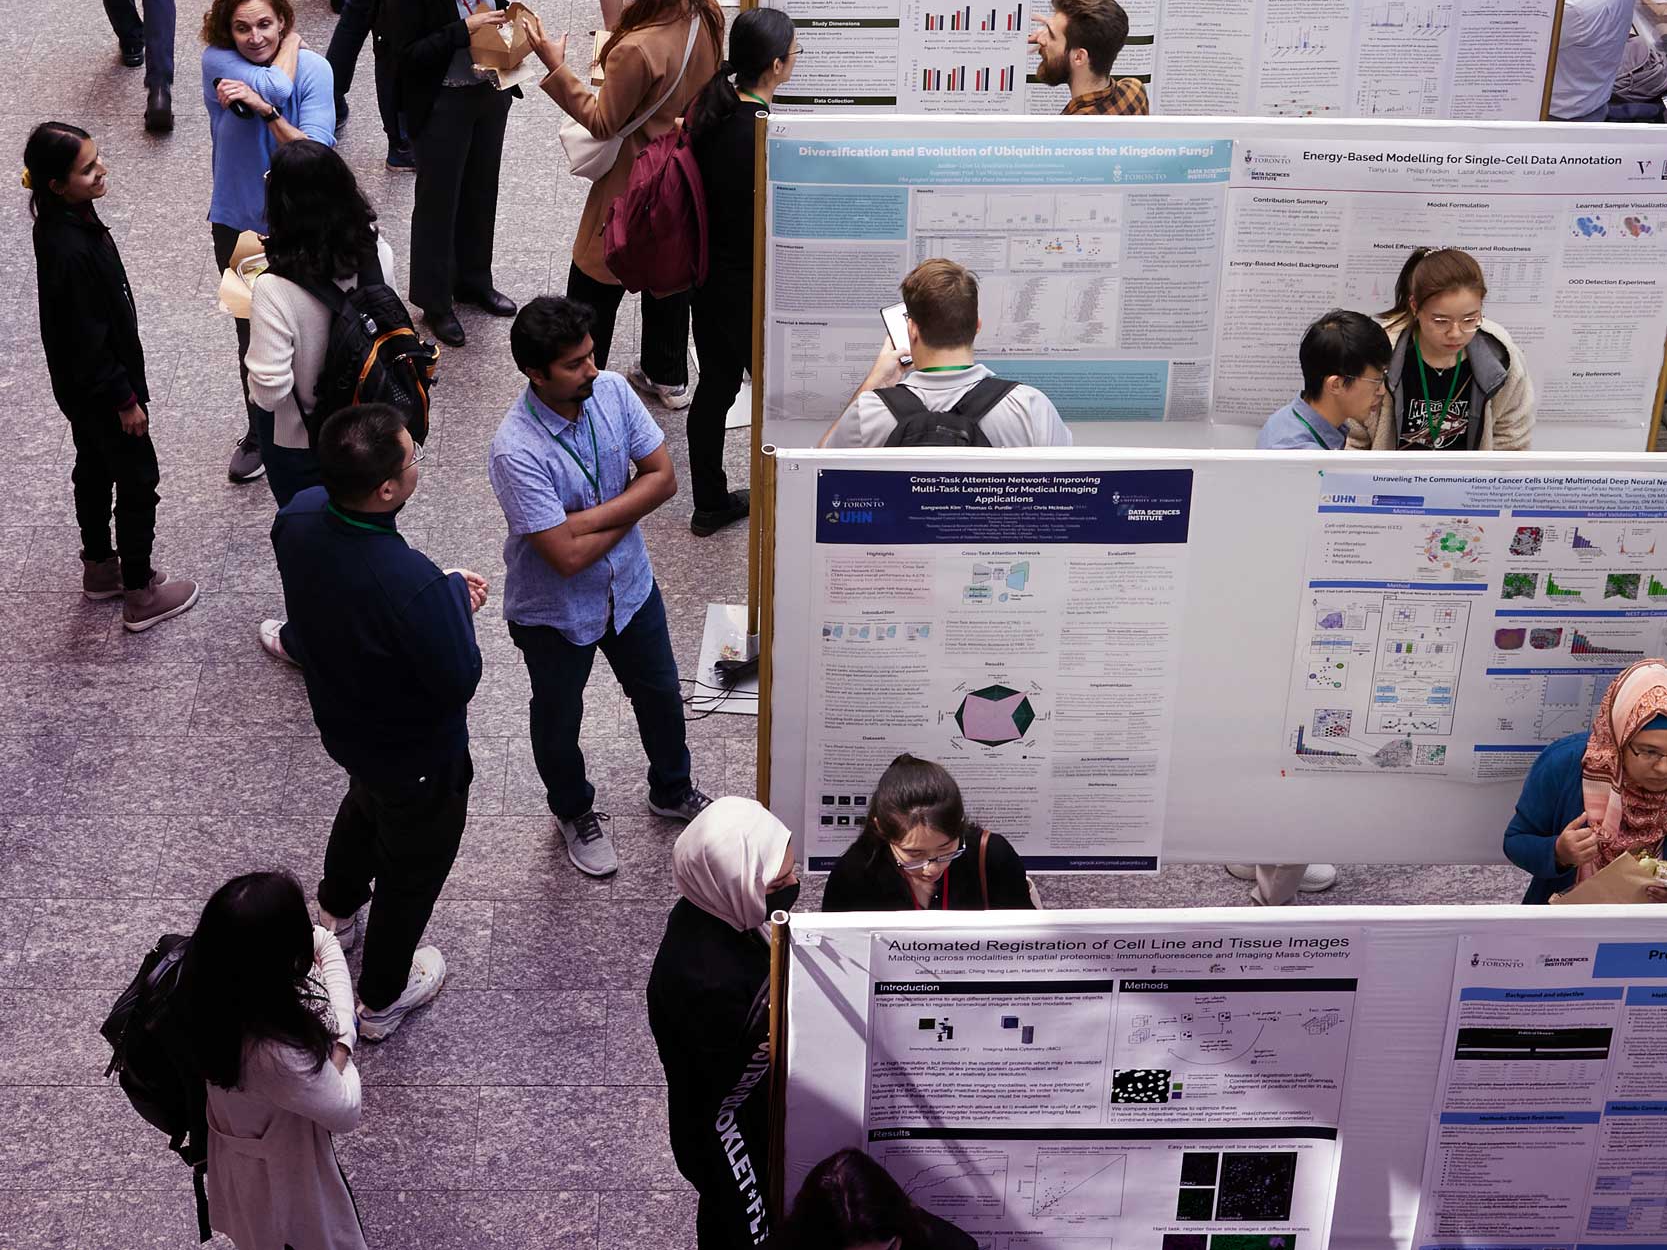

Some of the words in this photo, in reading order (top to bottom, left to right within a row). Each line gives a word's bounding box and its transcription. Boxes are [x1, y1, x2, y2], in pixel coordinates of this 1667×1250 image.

[798, 146, 889, 157] Diversification
[891, 146, 915, 157] and
[917, 146, 977, 157] Evolution
[979, 145, 993, 156] of
[994, 145, 1053, 156] Ubiquitin
[1054, 147, 1095, 156] across
[1096, 146, 1118, 156] the
[1119, 145, 1177, 158] Kingdom
[1178, 145, 1214, 157] Fungi
[1303, 151, 1384, 164] Energy-Based
[1386, 153, 1444, 166] Modelling
[1446, 154, 1462, 164] for
[1465, 154, 1528, 167] Single-Cell
[1531, 155, 1557, 165] Data
[1559, 155, 1622, 165] Annotation
[962, 476, 1006, 484] Attention
[1053, 477, 1101, 485] Improving
[1372, 476, 1413, 484] Unraveling
[1429, 476, 1487, 484] Communication
[1543, 477, 1564, 486] Using
[1565, 477, 1608, 485] Multimodal
[1609, 478, 1630, 486] Deep
[911, 485, 960, 493] Multi-Task
[962, 486, 1004, 495] Learning
[1005, 485, 1019, 493] for
[1020, 485, 1058, 493] Medical
[1059, 485, 1098, 495] Imaging
[974, 495, 1034, 504] Applications
[1332, 495, 1356, 504] UHN
[887, 940, 981, 952] Automated
[986, 939, 1087, 953] Registration
[1092, 939, 1109, 950] of
[1113, 939, 1146, 950] Cell
[1151, 939, 1186, 950] Line
[1192, 938, 1223, 949] and
[1230, 937, 1283, 949] Tissue
[1288, 937, 1350, 951] Images
[888, 954, 931, 963] Matching
[1027, 953, 1058, 961] spatial
[1060, 953, 1114, 961] proteomics:
[1116, 952, 1213, 960] Immunofluorescence
[1235, 952, 1273, 960] Imaging
[1302, 950, 1351, 959] Cytometry
[880, 984, 940, 992] Introduction
[1124, 981, 1169, 990] Methods
[873, 1130, 911, 1138] Results
